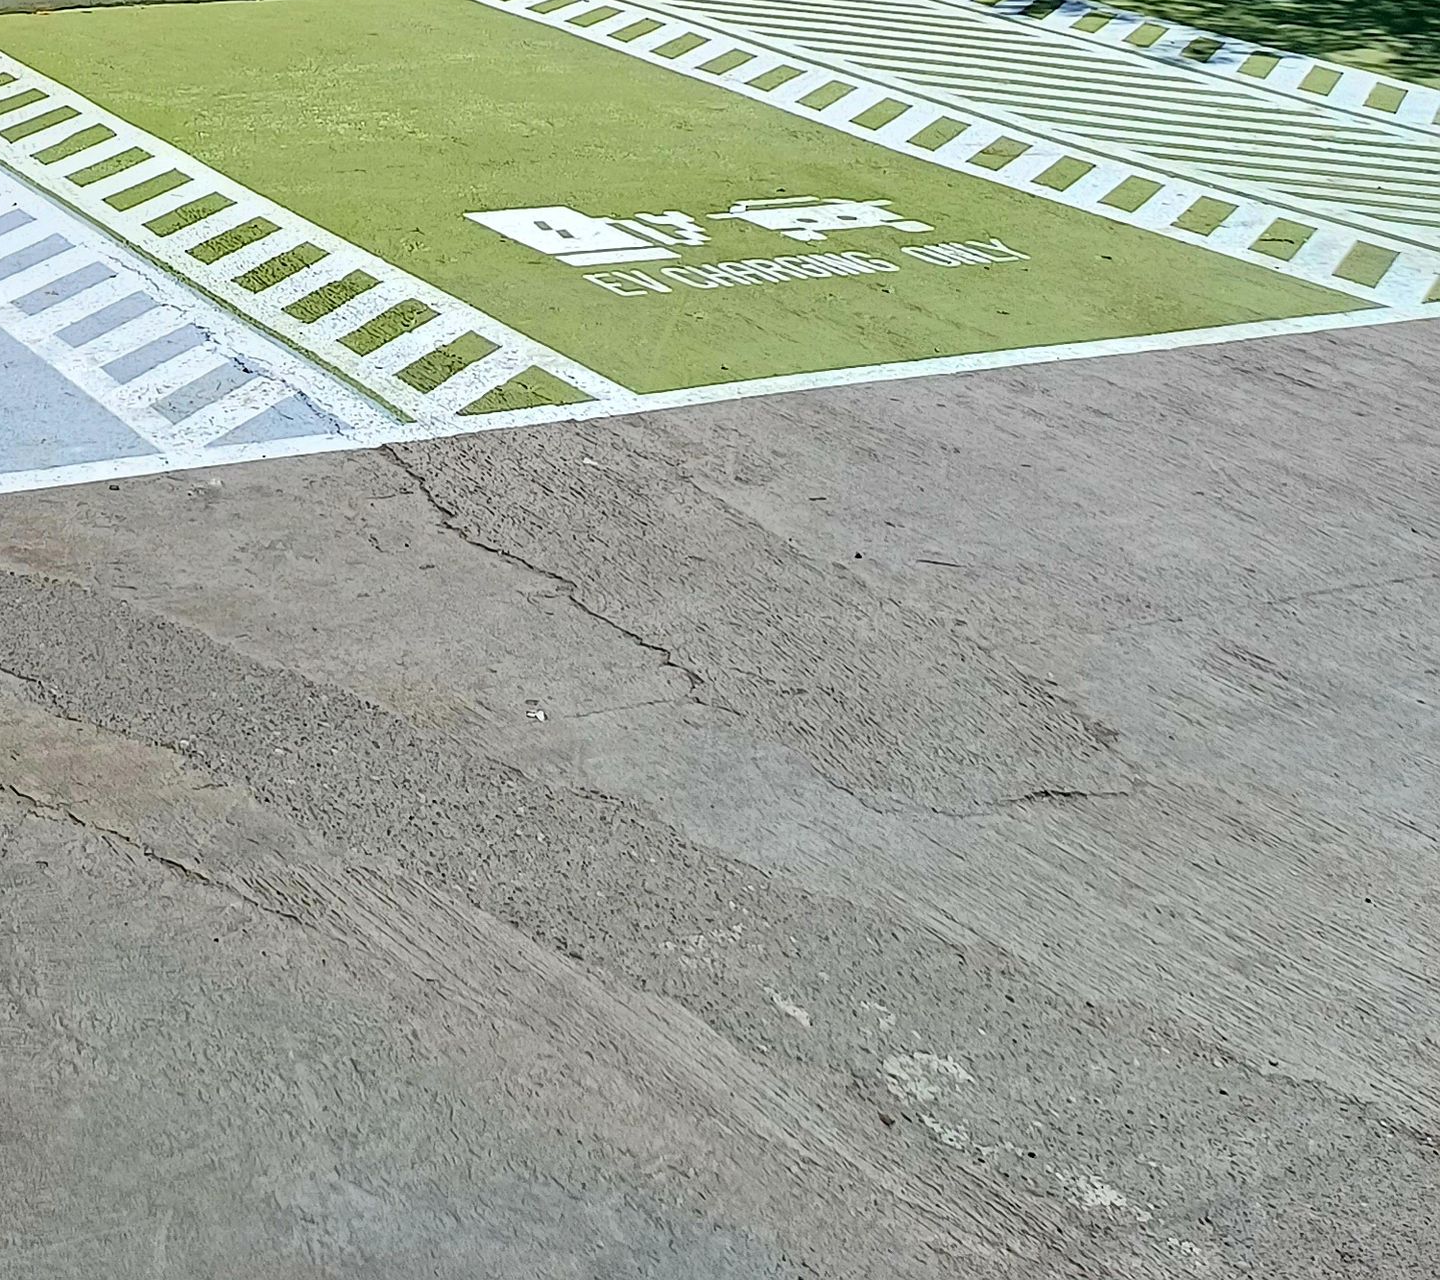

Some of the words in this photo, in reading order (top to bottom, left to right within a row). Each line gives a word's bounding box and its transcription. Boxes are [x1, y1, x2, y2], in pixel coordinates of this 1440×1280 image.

[582, 269, 673, 297] EV
[661, 251, 900, 289] CHARGING
[901, 238, 1031, 268] ONLY
